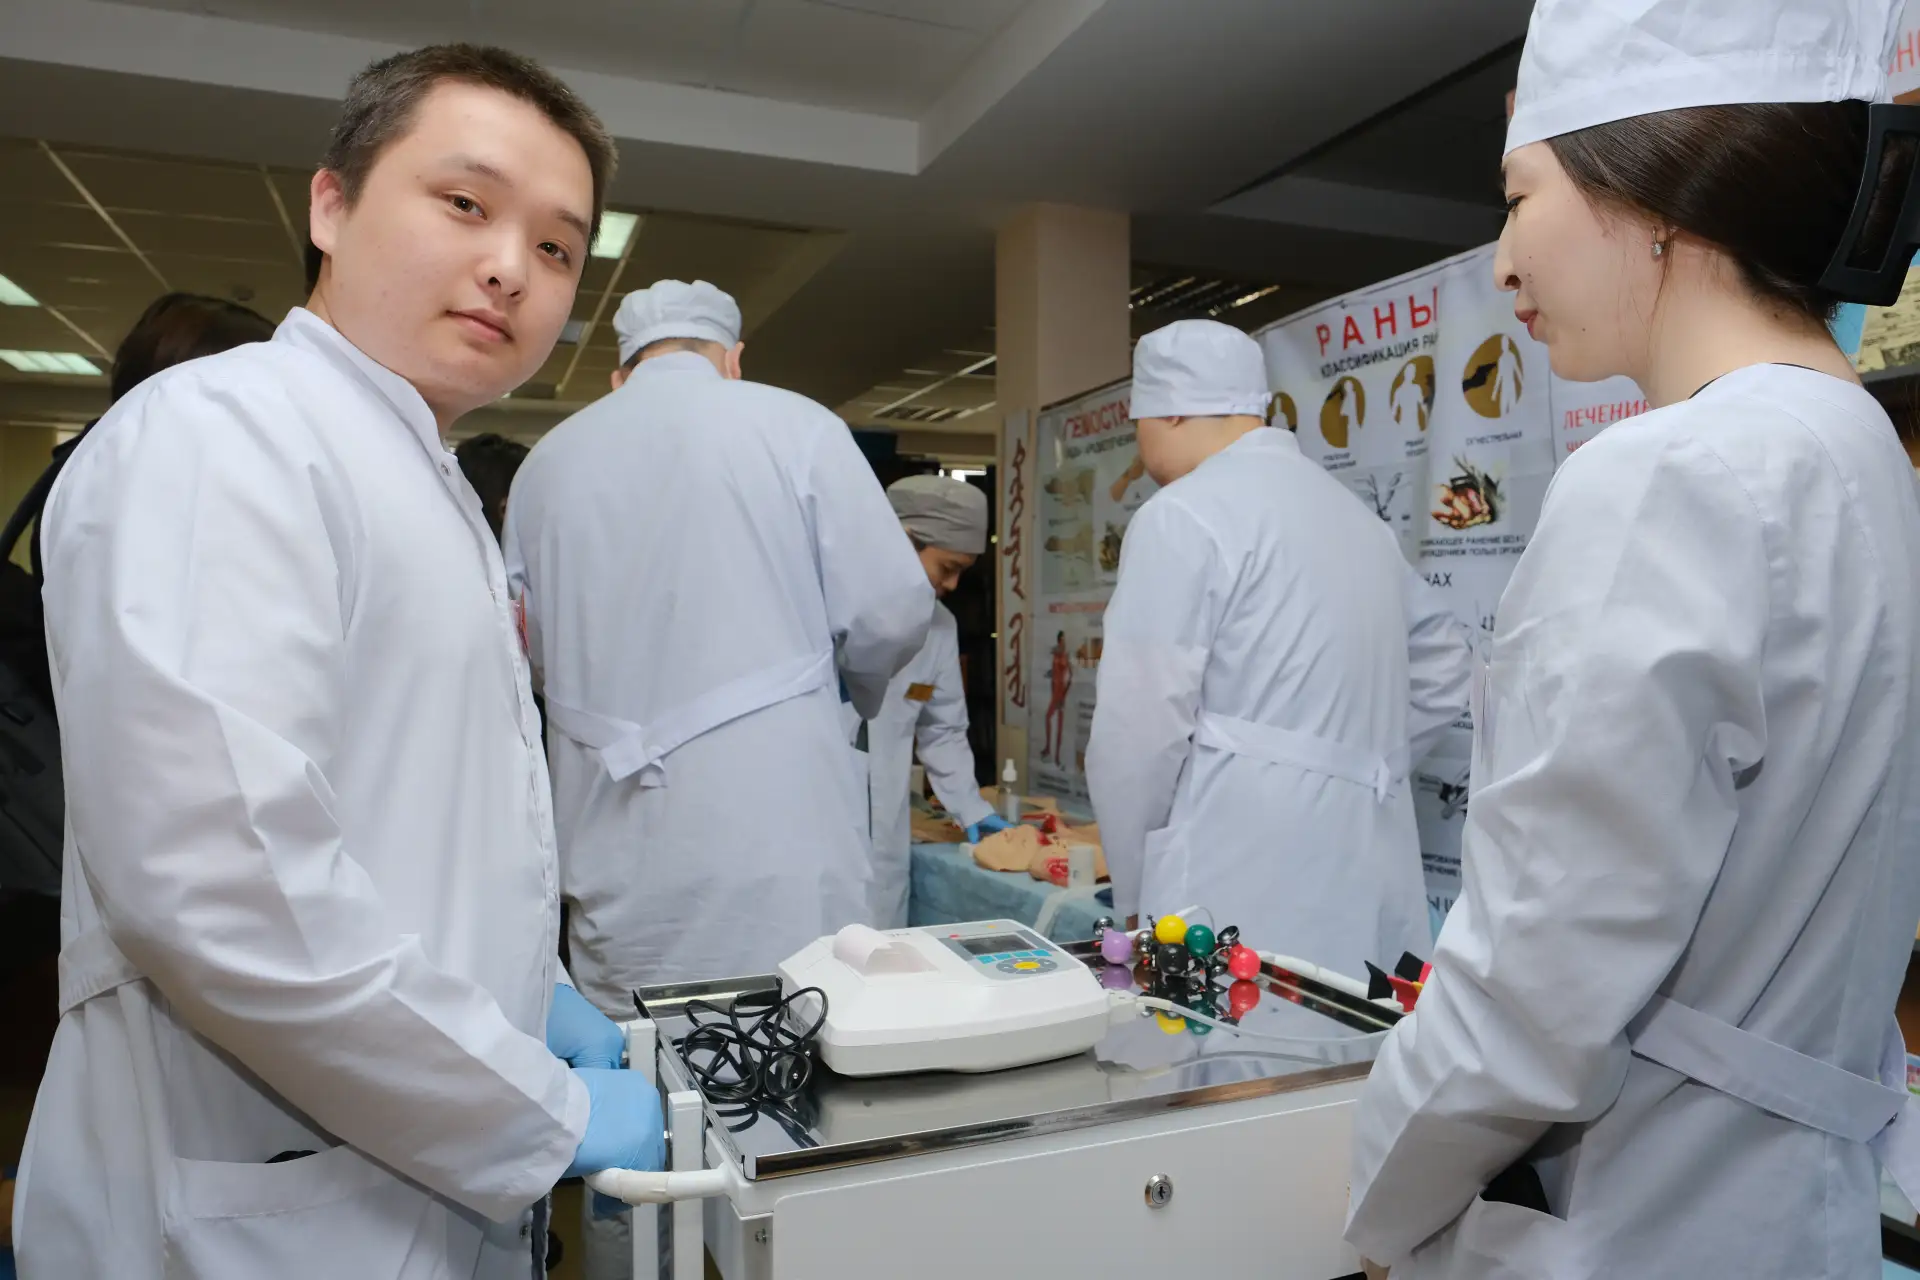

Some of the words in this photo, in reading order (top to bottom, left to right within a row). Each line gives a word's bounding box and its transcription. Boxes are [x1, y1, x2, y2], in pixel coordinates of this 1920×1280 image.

[1315, 285, 1438, 358] РАНЫ
[1320, 338, 1419, 378] КЛАССИФИКАЦИЯ
[1063, 398, 1130, 439] ГЕМОСТА
